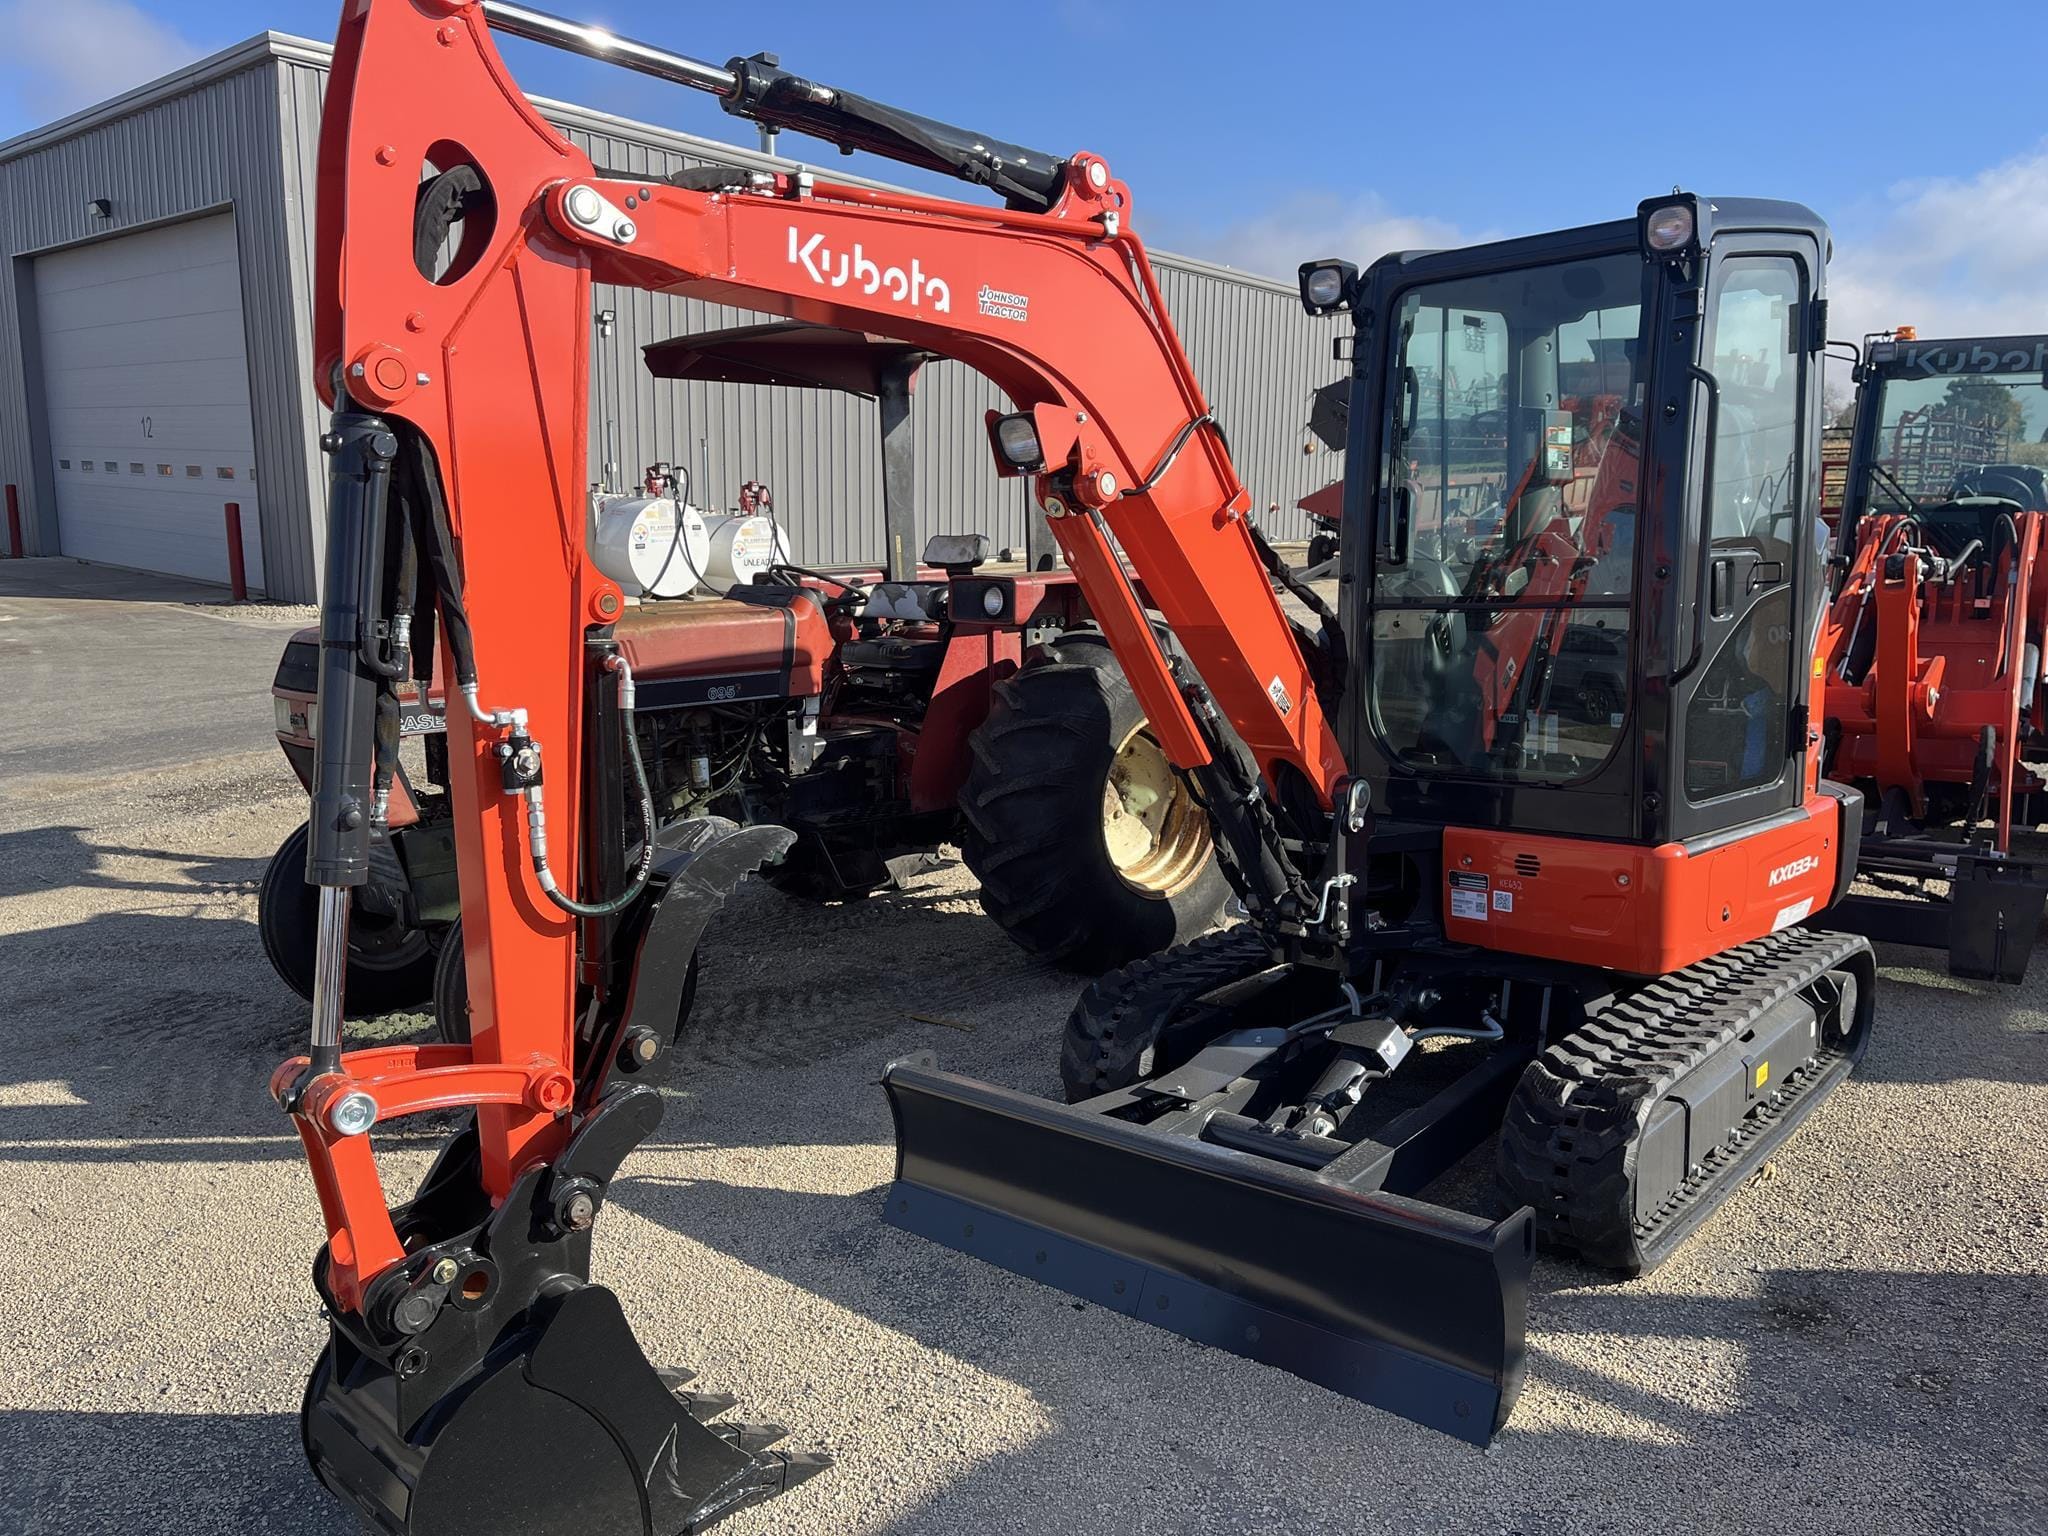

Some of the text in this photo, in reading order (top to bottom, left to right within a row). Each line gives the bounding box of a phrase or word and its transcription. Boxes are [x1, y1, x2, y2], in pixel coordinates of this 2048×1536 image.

[788, 226, 951, 313] Kubota
[979, 286, 1027, 307] JOHNSON
[979, 300, 1027, 320] TRACTOR
[141, 416, 153, 438] 12
[707, 685, 736, 700] 695
[640, 798, 651, 827] Winner
[636, 845, 653, 881] EC215-08
[1768, 855, 1819, 887] KX033-4
